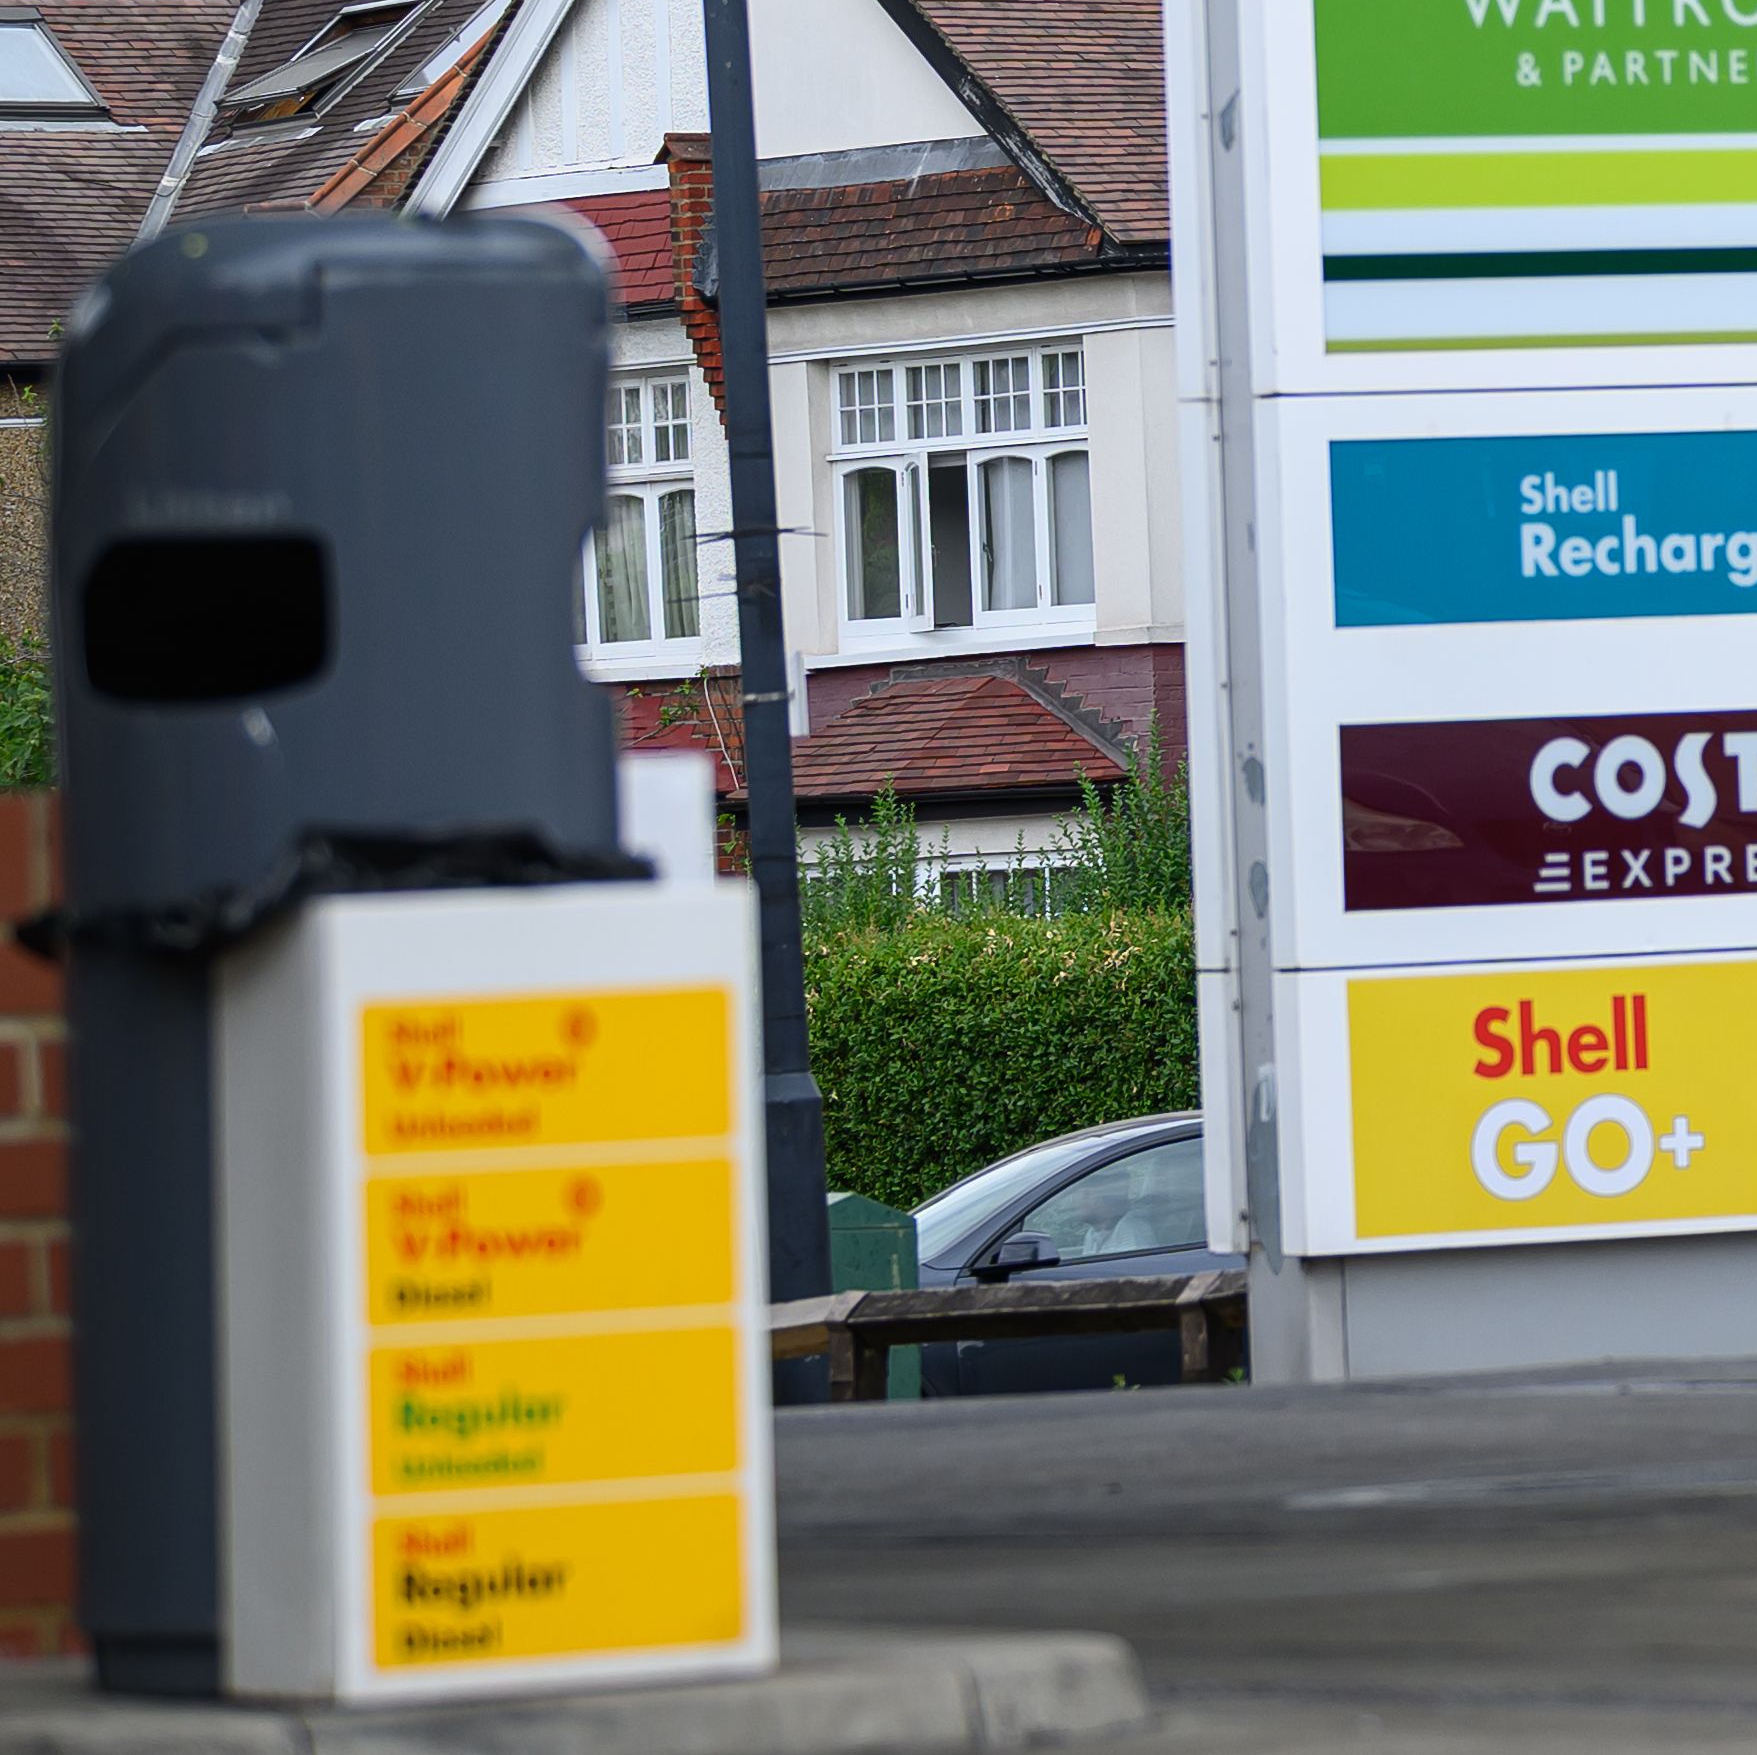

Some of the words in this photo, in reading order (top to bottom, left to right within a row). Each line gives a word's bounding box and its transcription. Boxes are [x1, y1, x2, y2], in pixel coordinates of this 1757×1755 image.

[1516, 52, 1542, 87] &
[1520, 470, 1619, 515] Shell
[1473, 994, 1649, 1079] Shell
[1471, 1093, 1705, 1202] GO+
